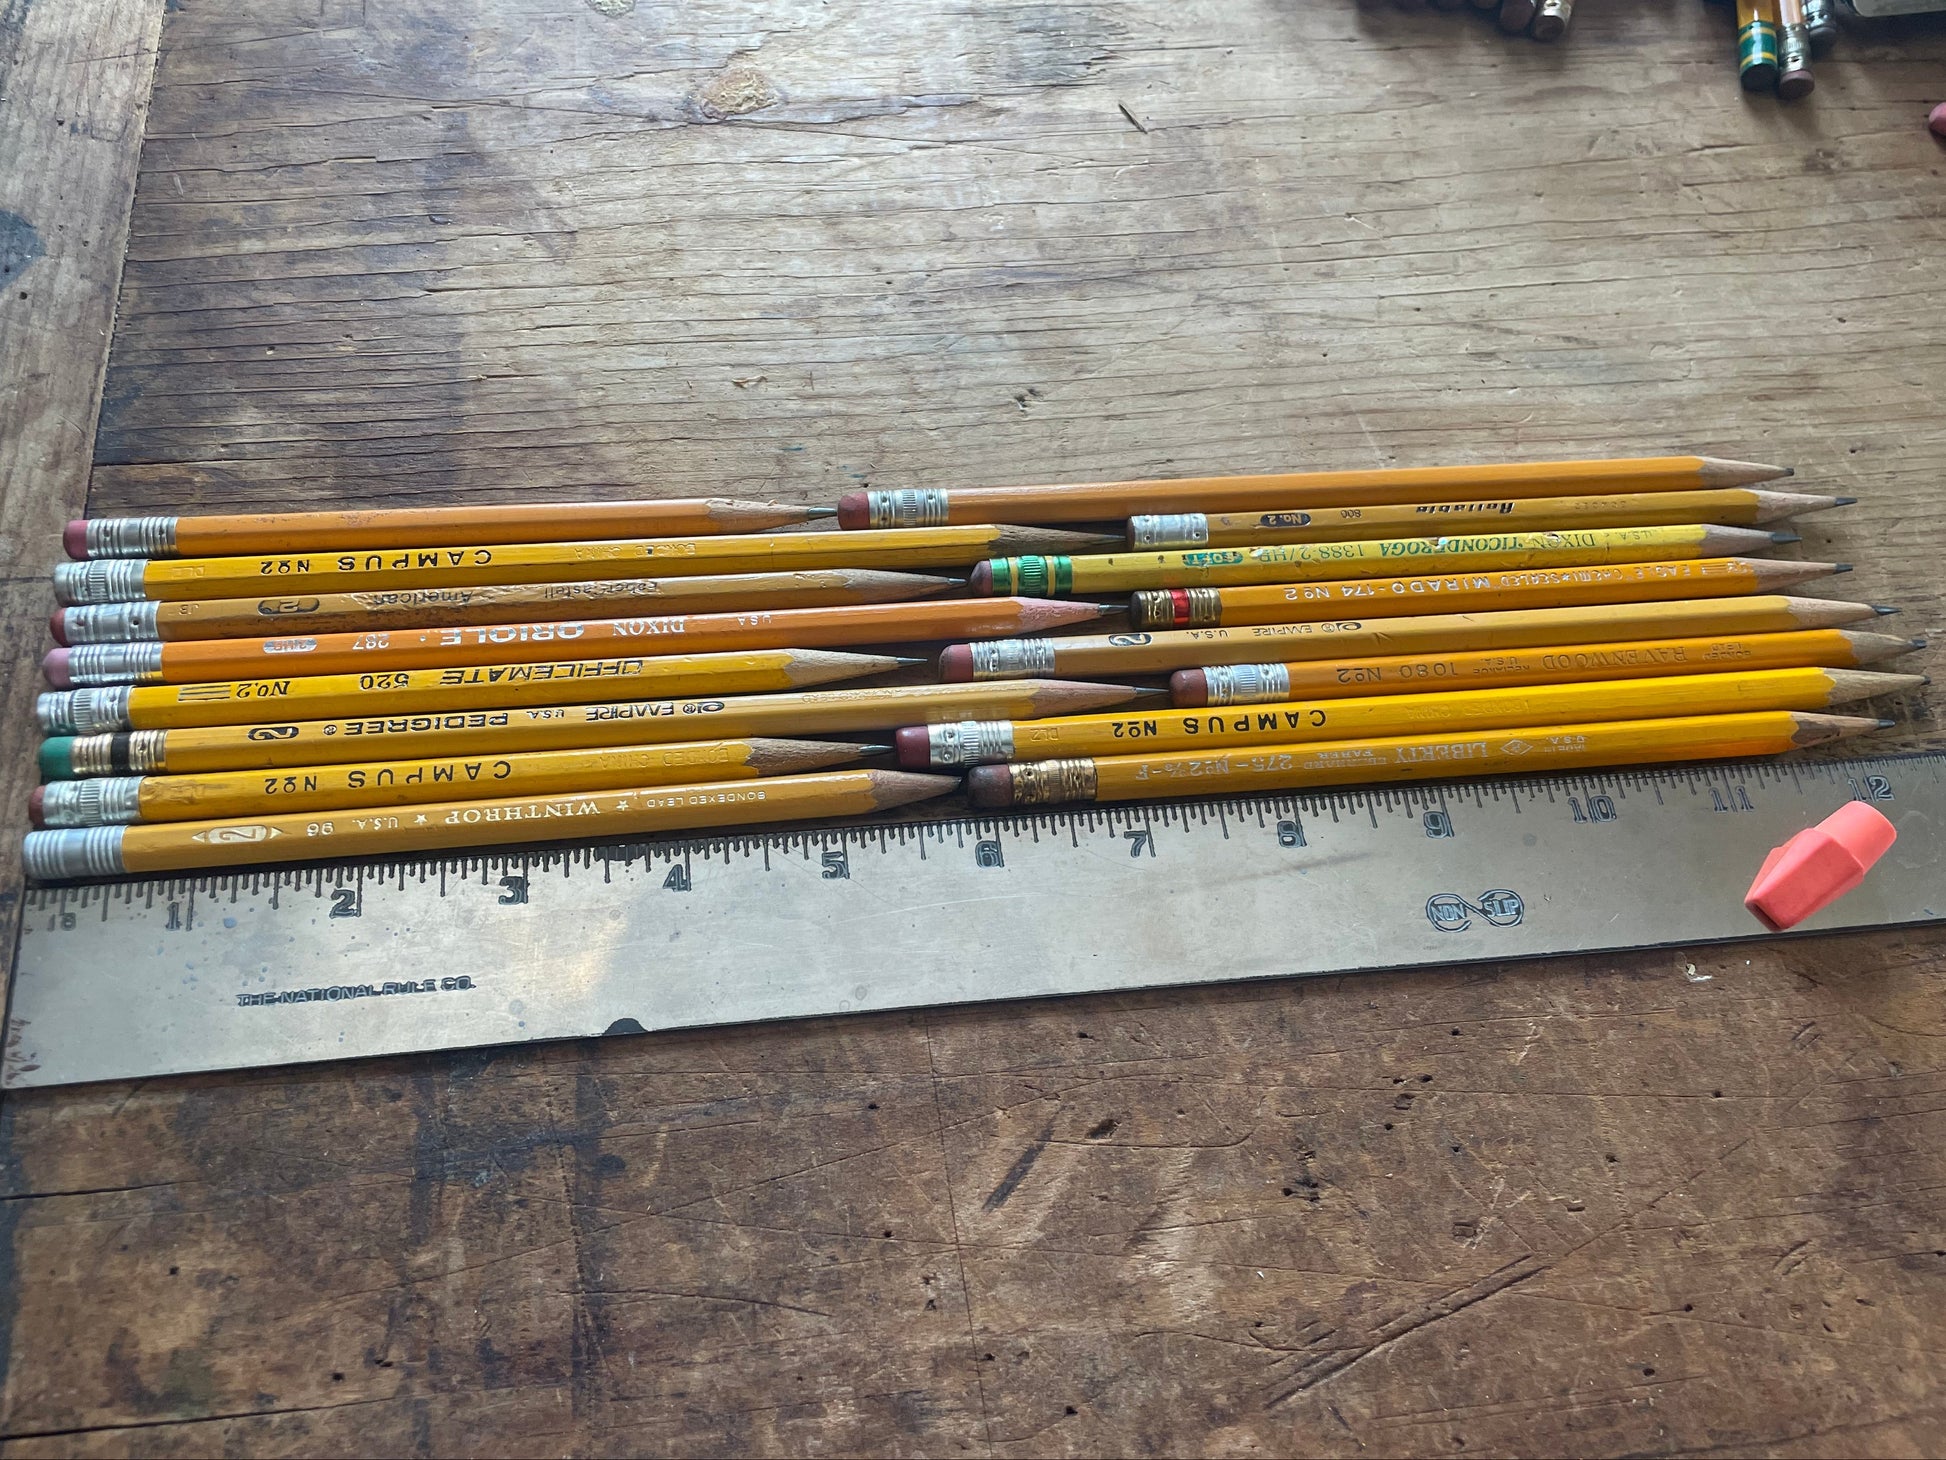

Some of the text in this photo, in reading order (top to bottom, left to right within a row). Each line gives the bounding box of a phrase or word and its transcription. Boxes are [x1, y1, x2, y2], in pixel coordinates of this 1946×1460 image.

[1340, 508, 1362, 520] 800
[1416, 503, 1516, 515] Reliable
[337, 550, 492, 572] CAMPUS
[1634, 564, 1691, 580] EAGLE
[373, 590, 474, 607] American
[440, 622, 585, 646] ORIOLE
[612, 617, 685, 637] DIXON
[1185, 628, 1229, 640] U.S.A.
[1251, 624, 1313, 637] EMPIRE
[352, 632, 390, 650] 287
[1541, 647, 1689, 670] RAVENWOOD
[440, 660, 644, 685] OFFICEMATE
[1399, 662, 1459, 679] 1080
[359, 673, 410, 691] 520
[525, 708, 565, 720] U.S.A.
[585, 701, 675, 721] EMPIRE
[1182, 709, 1327, 735] CAMPUS
[1316, 748, 1374, 760] FABER
[1394, 741, 1488, 764] LIBERTY
[347, 760, 511, 789] CAMPUS
[646, 795, 685, 808] LEAD
[684, 790, 767, 805] BONDEXED
[444, 801, 601, 824] WINTHROP
[306, 822, 335, 837] 96
[351, 816, 399, 831] U.S.A.
[329, 889, 358, 919] 2
[498, 875, 525, 905] 3
[662, 863, 688, 892] 4
[821, 851, 848, 880] 5
[975, 840, 1001, 868] 6
[1123, 830, 1148, 858] 7
[1276, 820, 1301, 848] 8
[1422, 811, 1450, 839] 9
[1567, 795, 1617, 824] 10
[1708, 785, 1755, 814] 11
[1847, 774, 1896, 803] 12
[1430, 899, 1520, 921] NON SLIP
[236, 974, 477, 1007] THE NATIONAL RULE CO.
